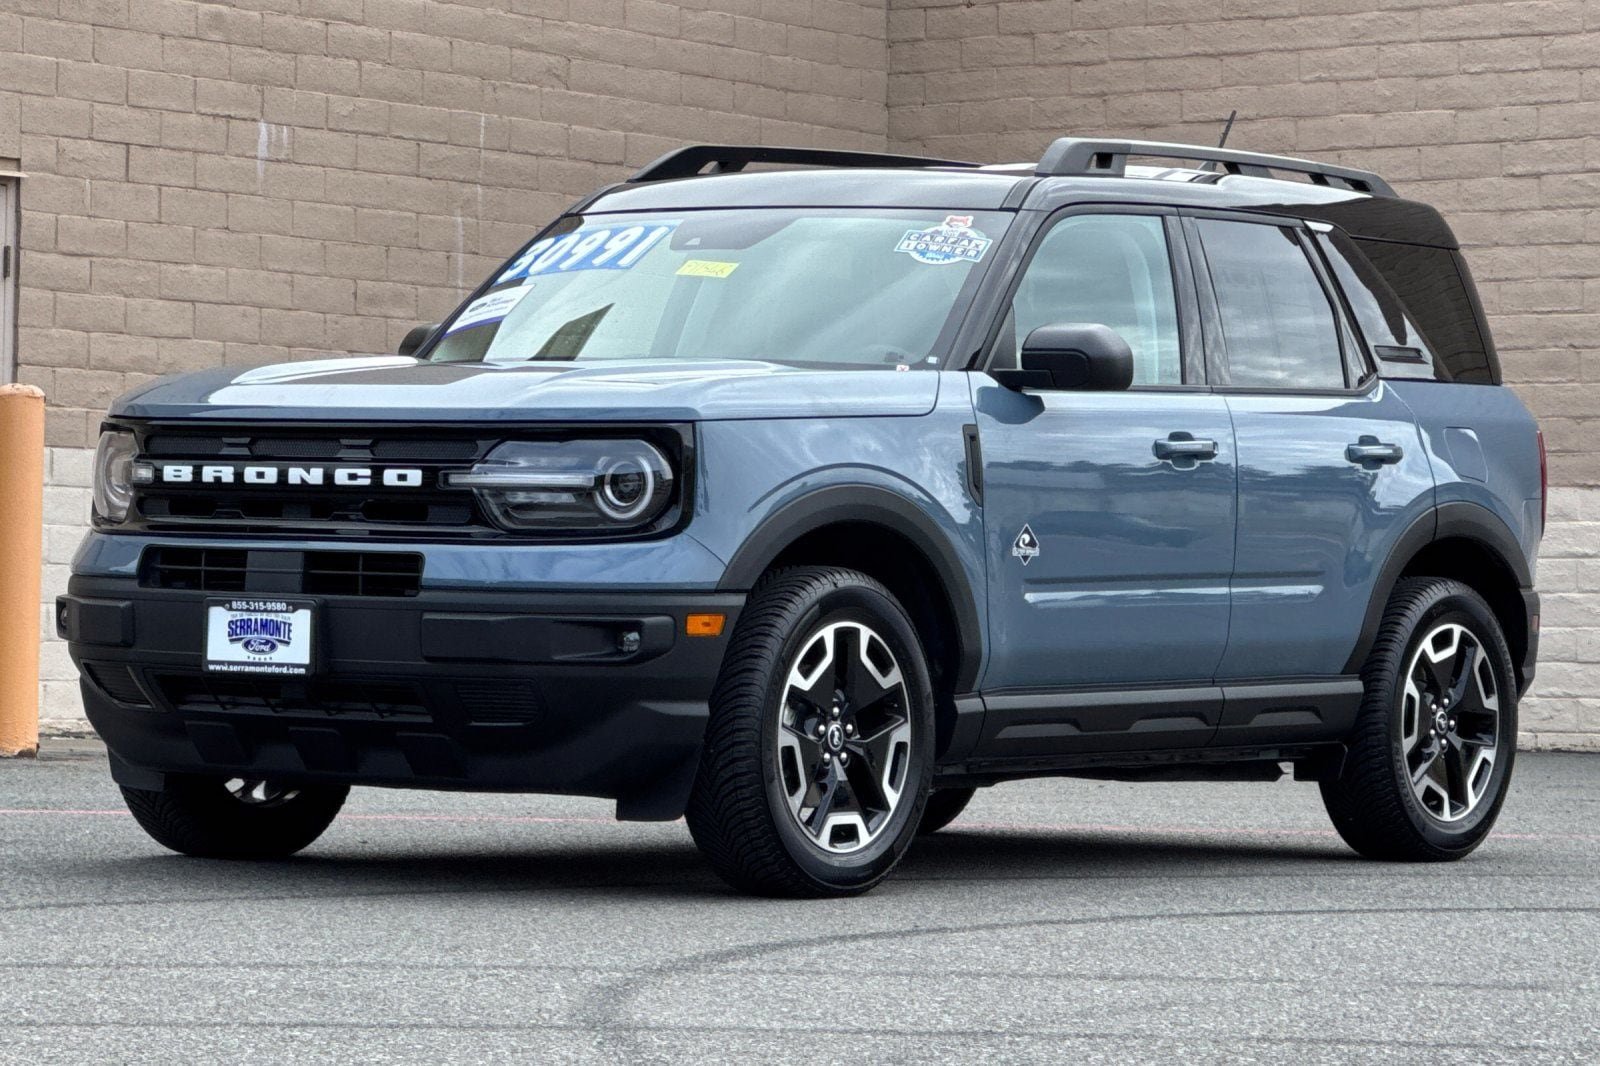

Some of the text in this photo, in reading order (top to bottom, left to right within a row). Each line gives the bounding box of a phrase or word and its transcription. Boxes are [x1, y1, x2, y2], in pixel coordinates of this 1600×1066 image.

[908, 233, 987, 250] CARFAX
[496, 226, 669, 284] 30991
[916, 243, 978, 257] OWNER
[163, 465, 422, 487] BRONCO
[231, 601, 287, 611] 855-315-9580
[227, 617, 292, 641] SERRAMONTE
[247, 639, 272, 652] Ford
[208, 663, 306, 675] www.serramonteford.com
